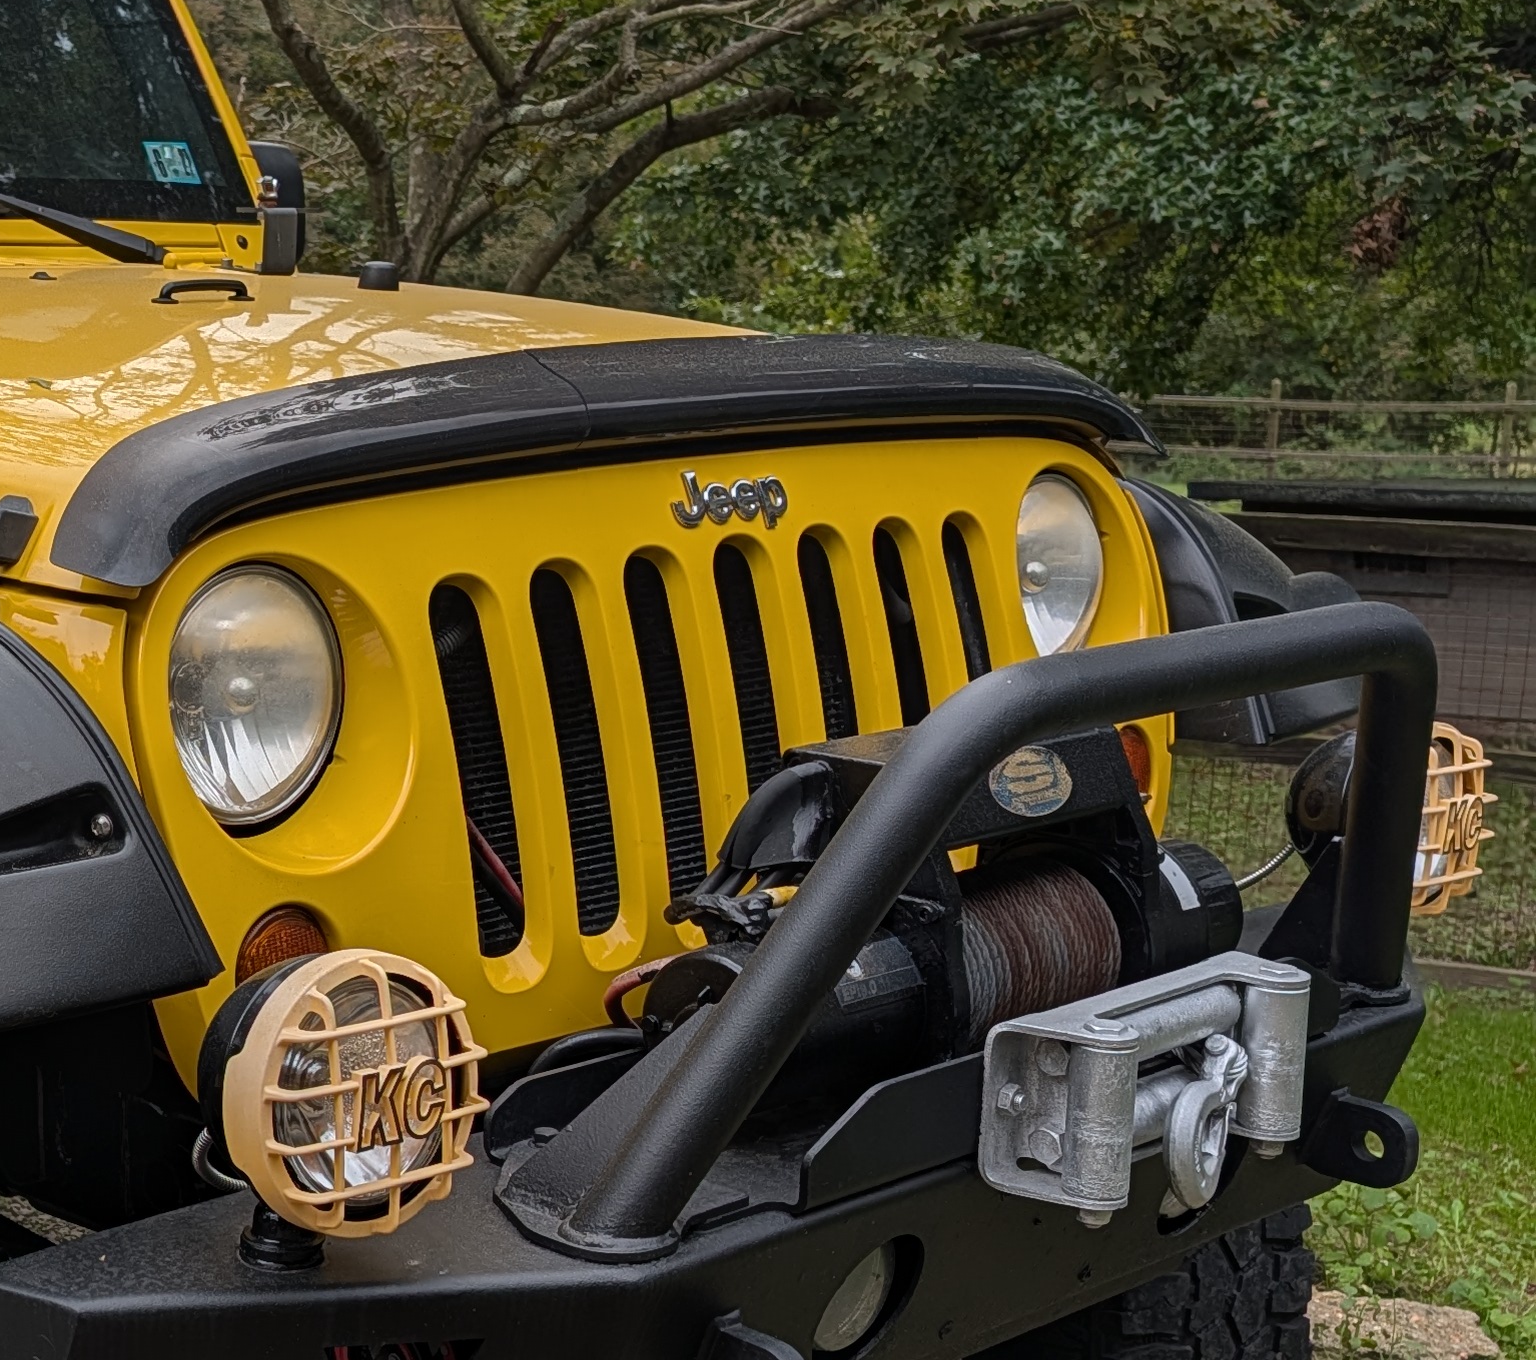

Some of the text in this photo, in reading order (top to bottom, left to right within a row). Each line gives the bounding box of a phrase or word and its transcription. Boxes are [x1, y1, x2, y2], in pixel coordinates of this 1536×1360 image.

[670, 470, 788, 530] Jeep
[1442, 794, 1484, 855] KC
[350, 1055, 448, 1153] KC
